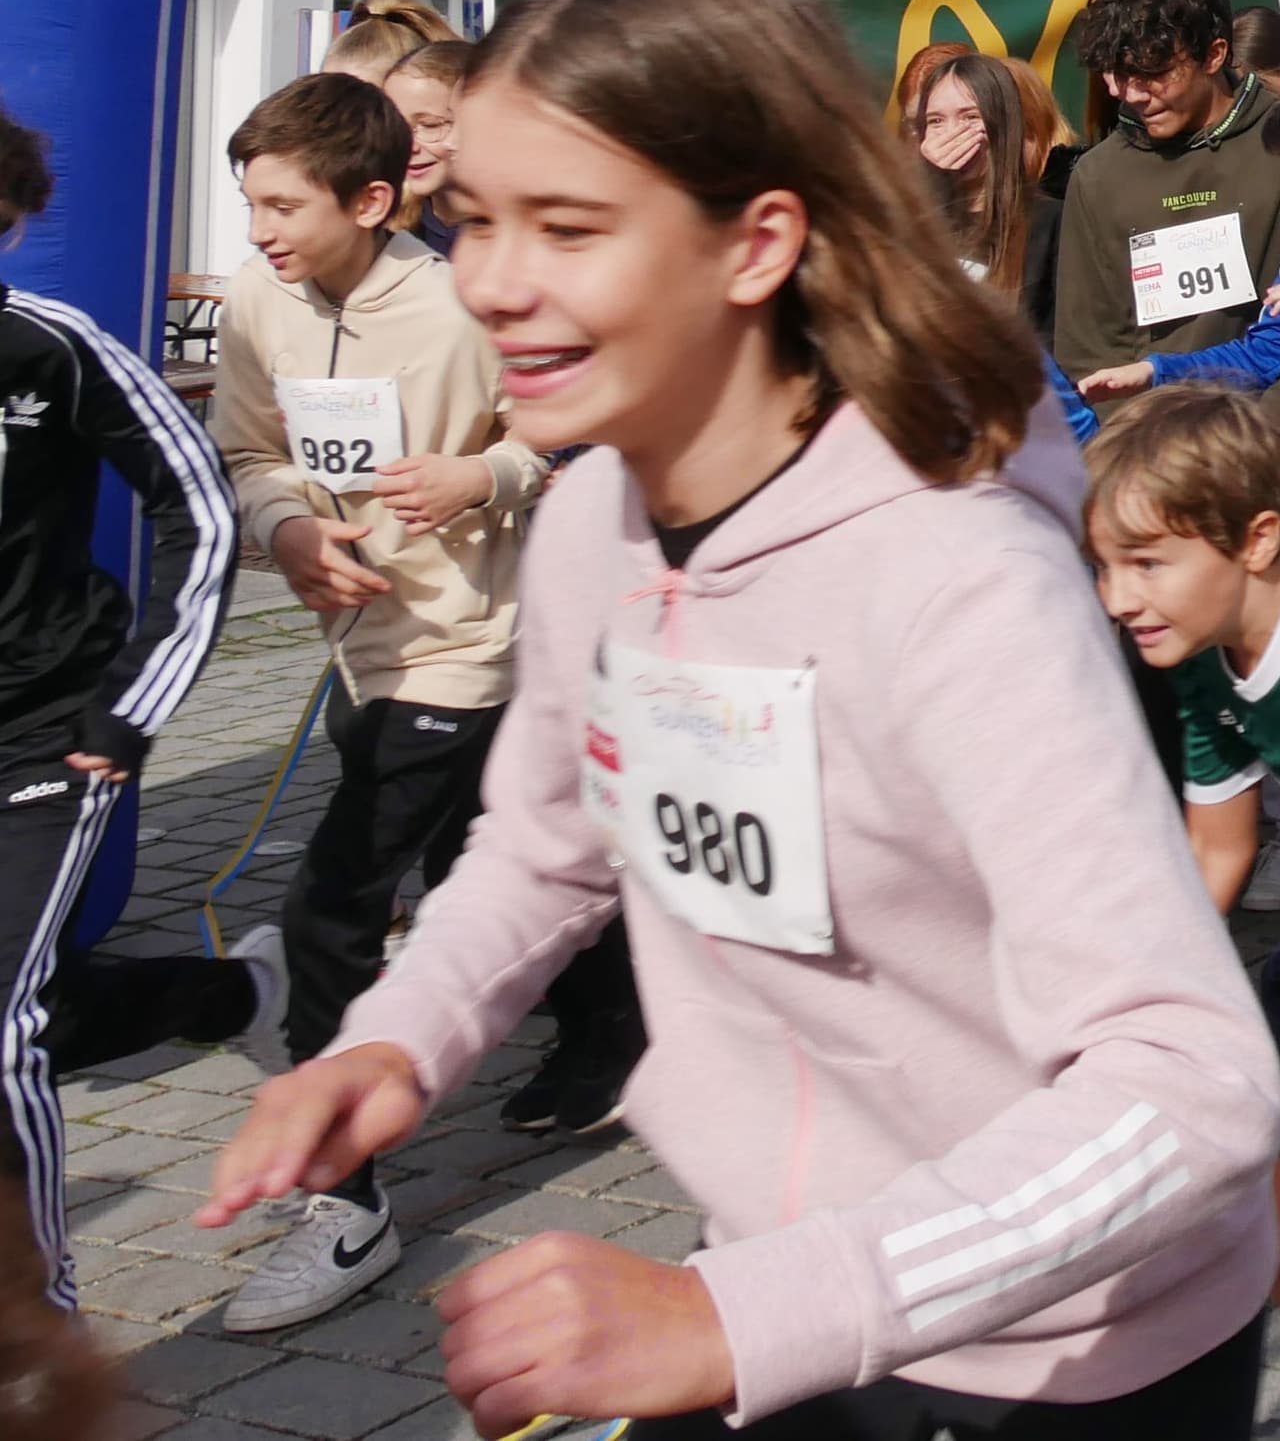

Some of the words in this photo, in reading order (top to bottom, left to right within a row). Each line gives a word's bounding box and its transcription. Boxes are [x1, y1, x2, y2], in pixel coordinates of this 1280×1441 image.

[1162, 191, 1217, 207] VANCOUVER
[1178, 263, 1230, 299] 991
[301, 437, 377, 474] 982
[9, 781, 69, 803] adidas
[656, 793, 772, 896] 980
